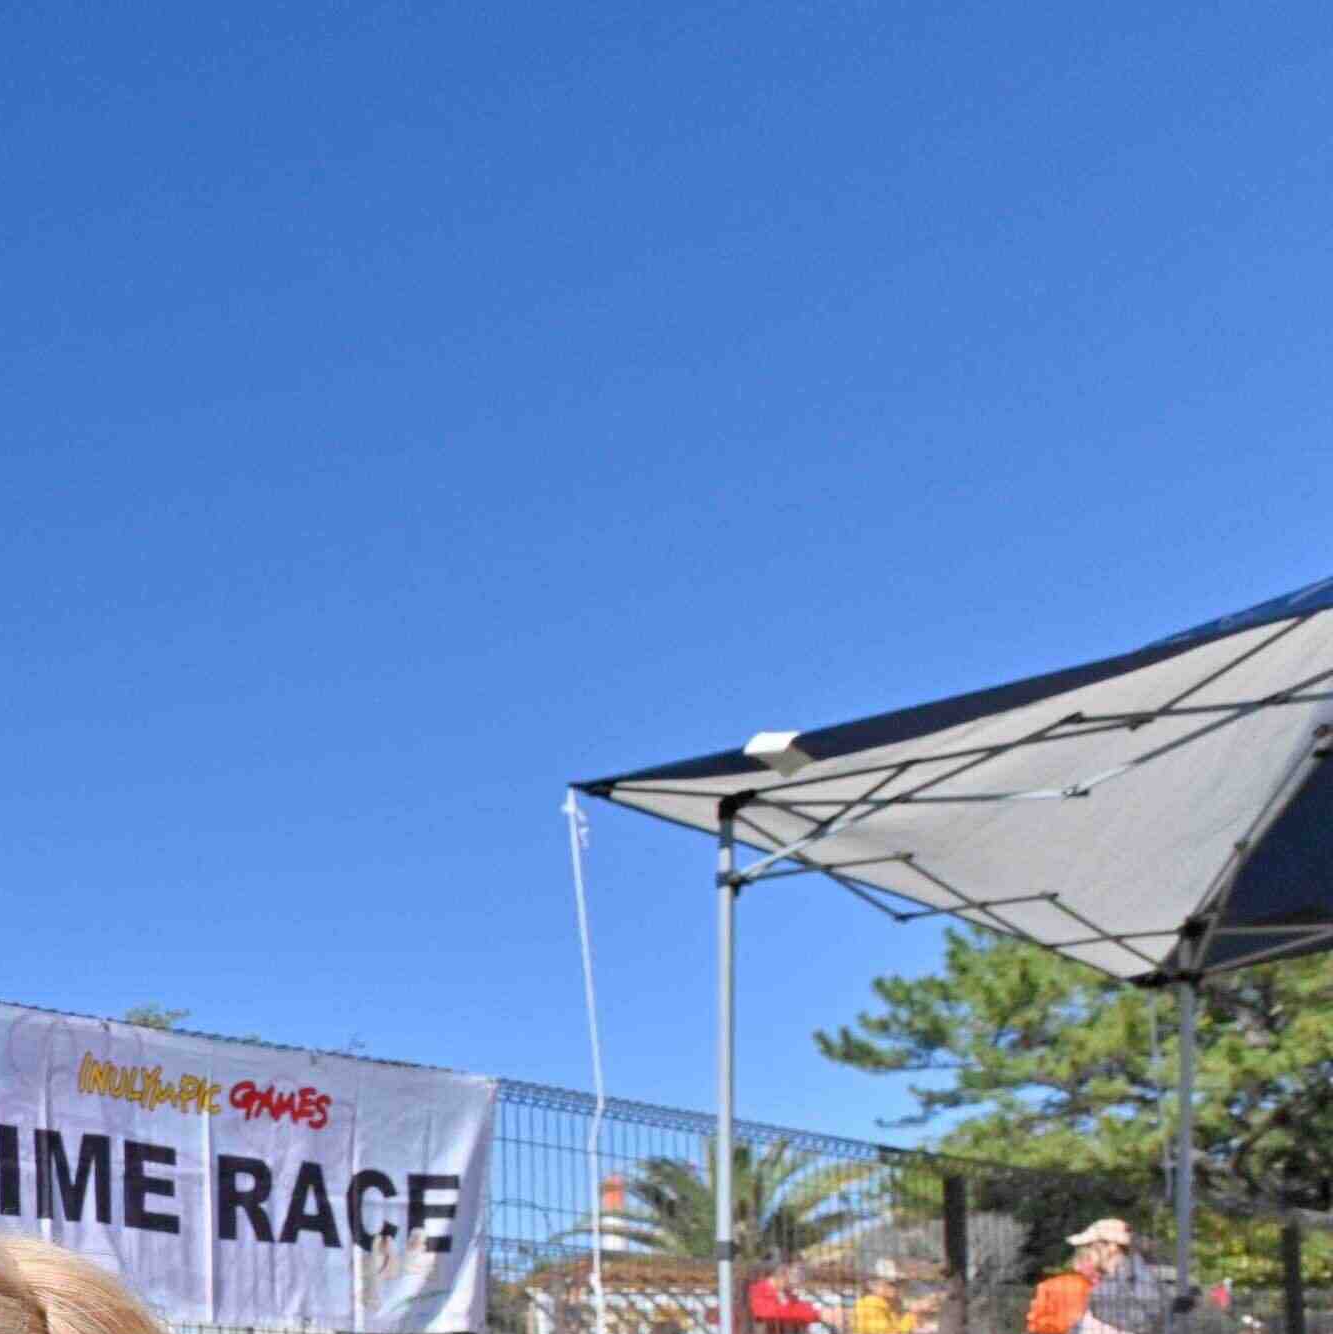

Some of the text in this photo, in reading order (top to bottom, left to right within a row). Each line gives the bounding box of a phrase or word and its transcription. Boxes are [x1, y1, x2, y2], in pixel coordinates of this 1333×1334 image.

[78, 1051, 222, 1116] INULYMPIC
[229, 1080, 331, 1130] GAMES
[217, 1155, 460, 1253] RACE
